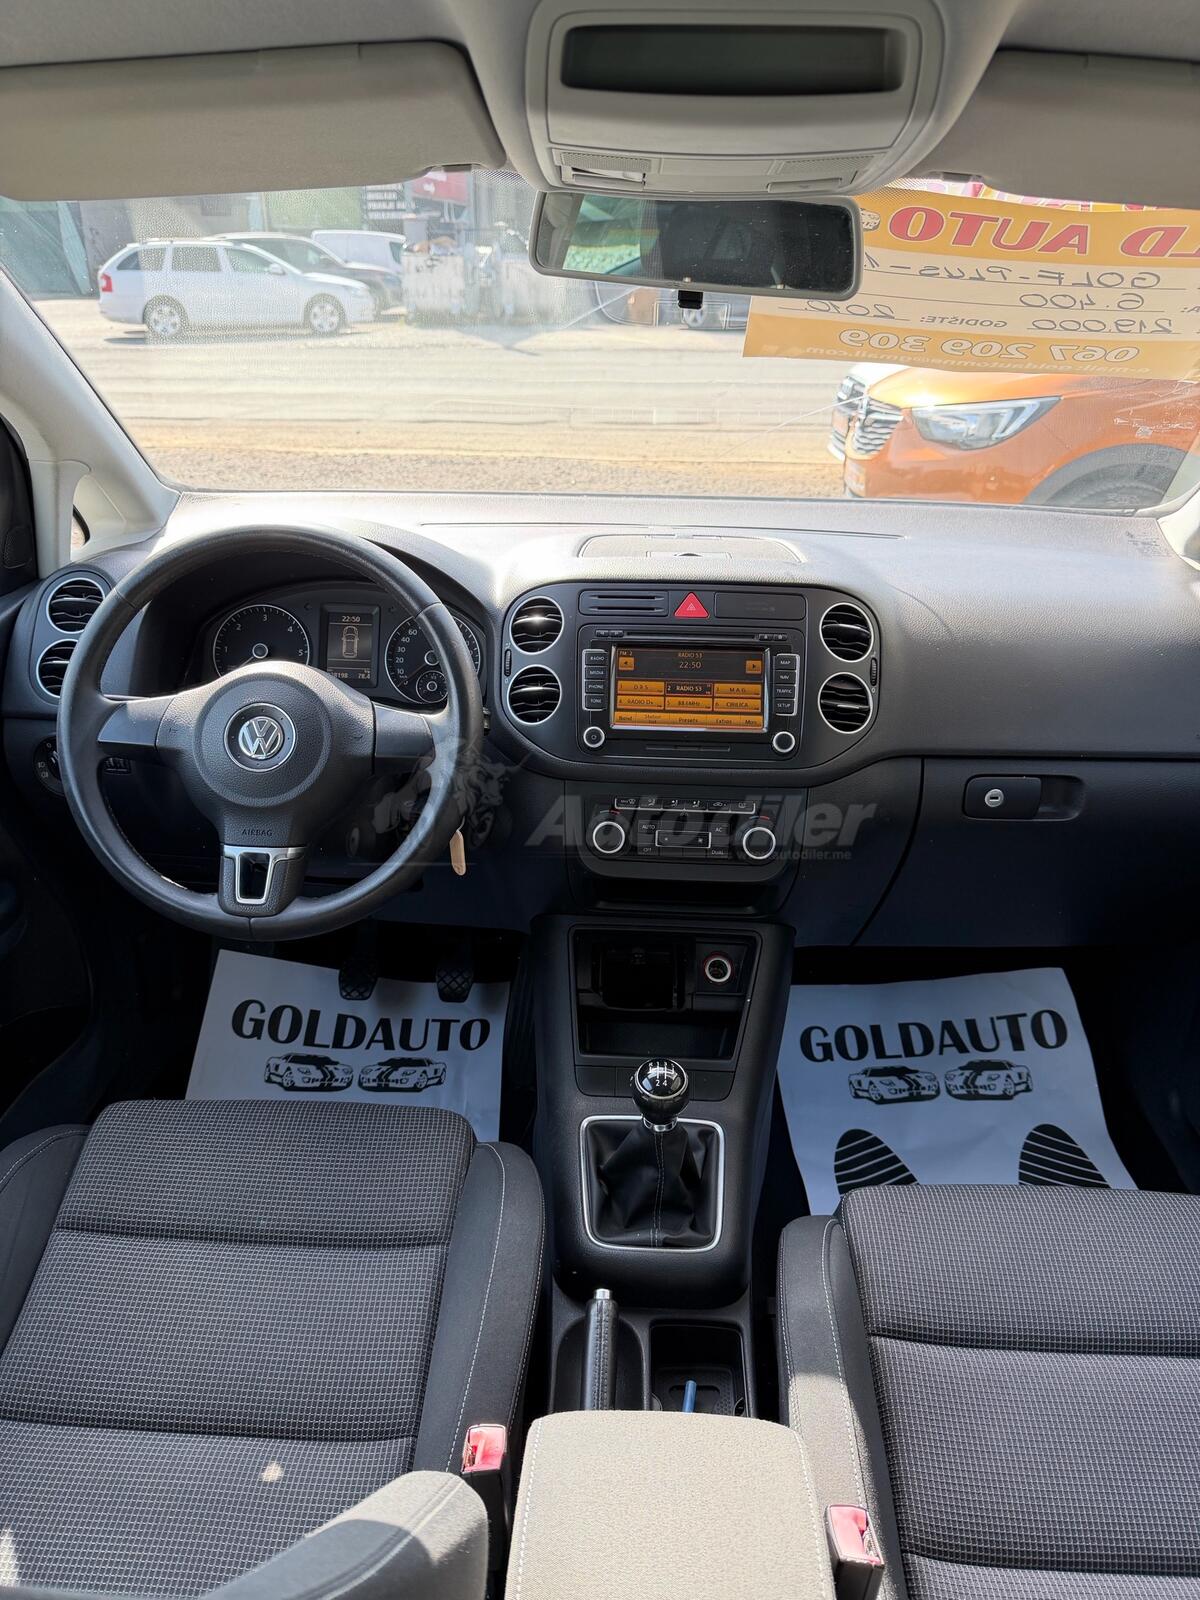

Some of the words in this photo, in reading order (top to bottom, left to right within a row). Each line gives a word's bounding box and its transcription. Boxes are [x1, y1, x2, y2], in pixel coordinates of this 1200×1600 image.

[262, 614, 268, 622] 3
[342, 615, 360, 623] 22:50
[298, 649, 303, 657] 5
[679, 661, 702, 669] 22:50
[242, 828, 273, 837] AIRBAG
[231, 998, 491, 1053] GOLDAUTO
[799, 1009, 1068, 1062] GOLDAUTO
[655, 1079, 660, 1087] 2
[662, 1079, 668, 1087] 4
